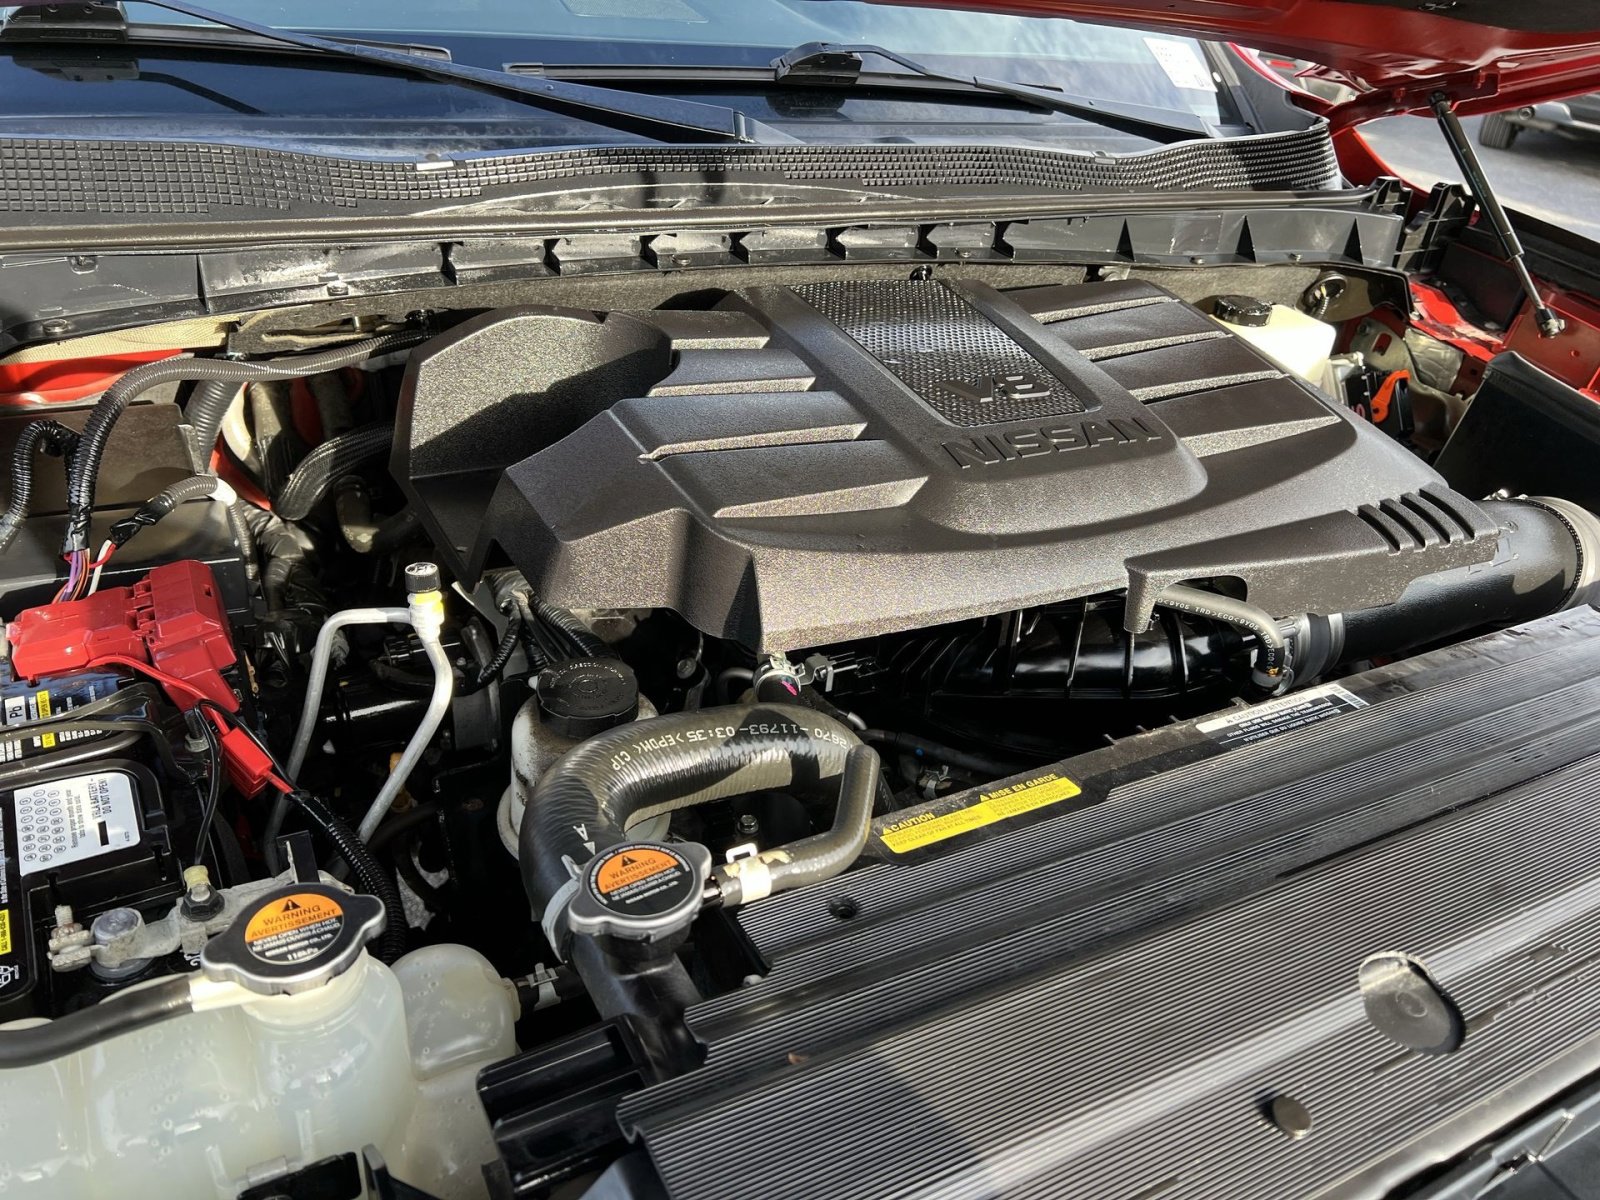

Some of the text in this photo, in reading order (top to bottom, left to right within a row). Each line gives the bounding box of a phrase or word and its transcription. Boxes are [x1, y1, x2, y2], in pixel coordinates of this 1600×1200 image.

[934, 374, 1050, 402] V8
[941, 417, 1162, 469] NISSAN
[9, 705, 22, 719] Pb
[610, 751, 631, 771] CIP
[88, 783, 101, 805] BATTERY
[988, 787, 1013, 799] MISE
[1014, 783, 1026, 792] EN
[1026, 774, 1059, 788] GARDE
[573, 823, 589, 841] A
[890, 812, 935, 832] CAUTION
[604, 860, 672, 890] AVERTISSEMENT
[609, 857, 657, 879] WARNING
[251, 908, 337, 938] AVERTISSEMENT
[263, 905, 321, 926] WARNING
